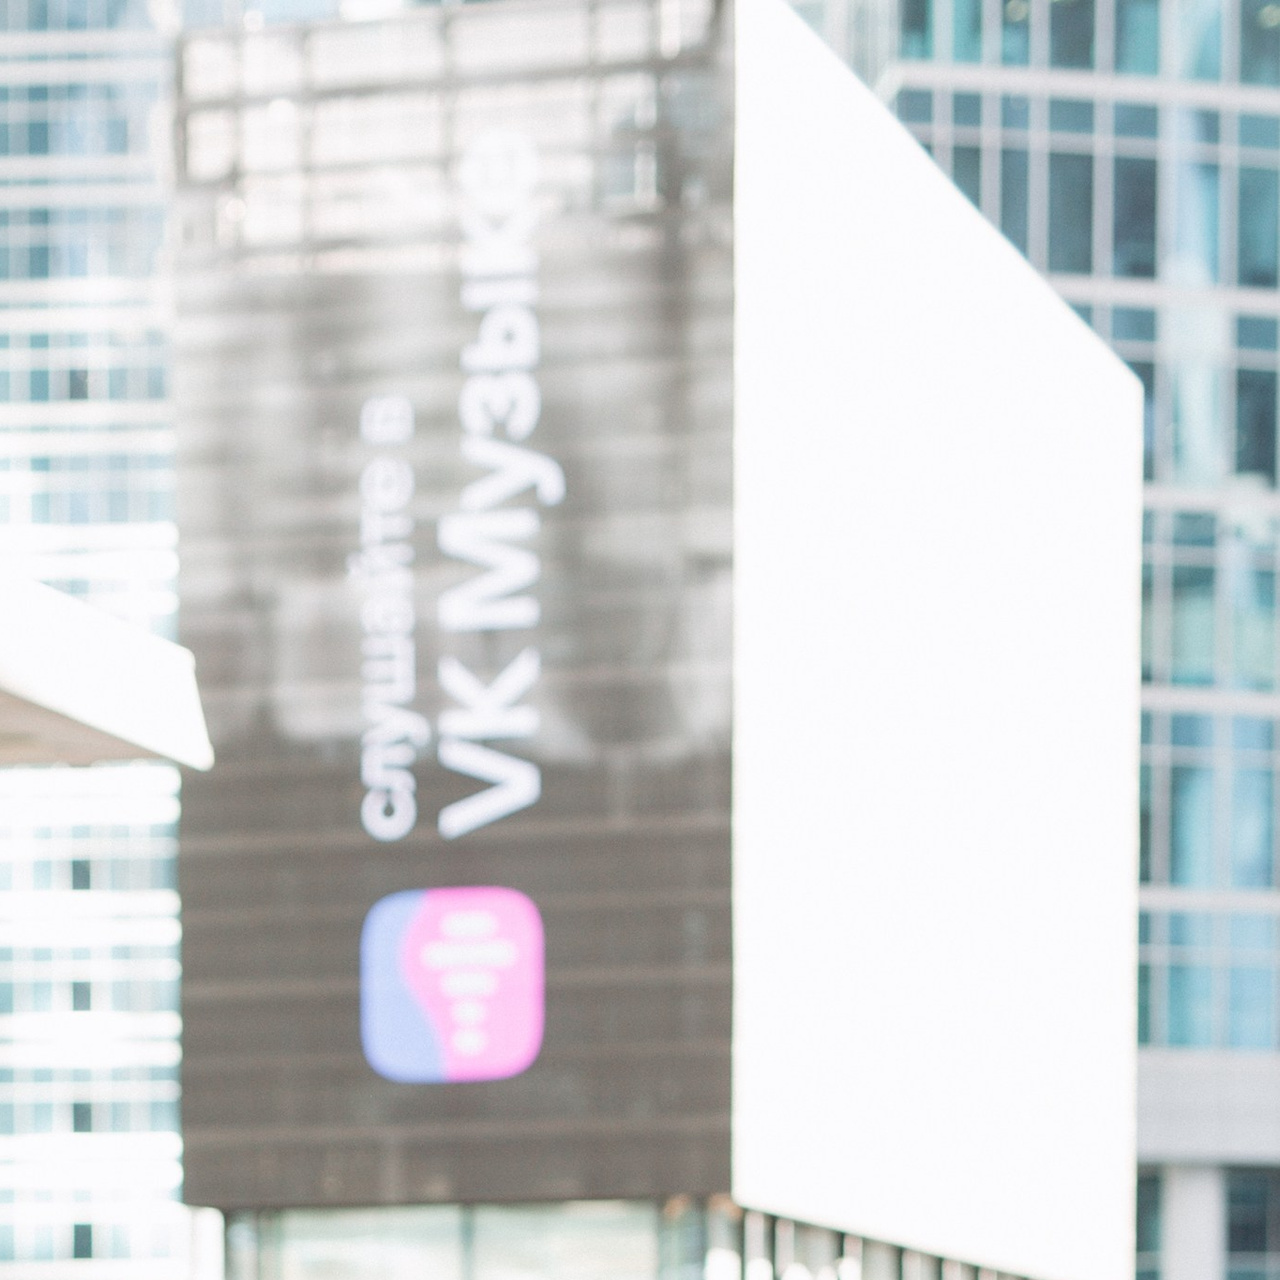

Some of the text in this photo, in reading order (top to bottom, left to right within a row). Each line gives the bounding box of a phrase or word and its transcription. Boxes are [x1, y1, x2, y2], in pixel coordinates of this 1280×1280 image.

[350, 398, 429, 841] слушайте в
[437, 127, 566, 840] VK Музыке
